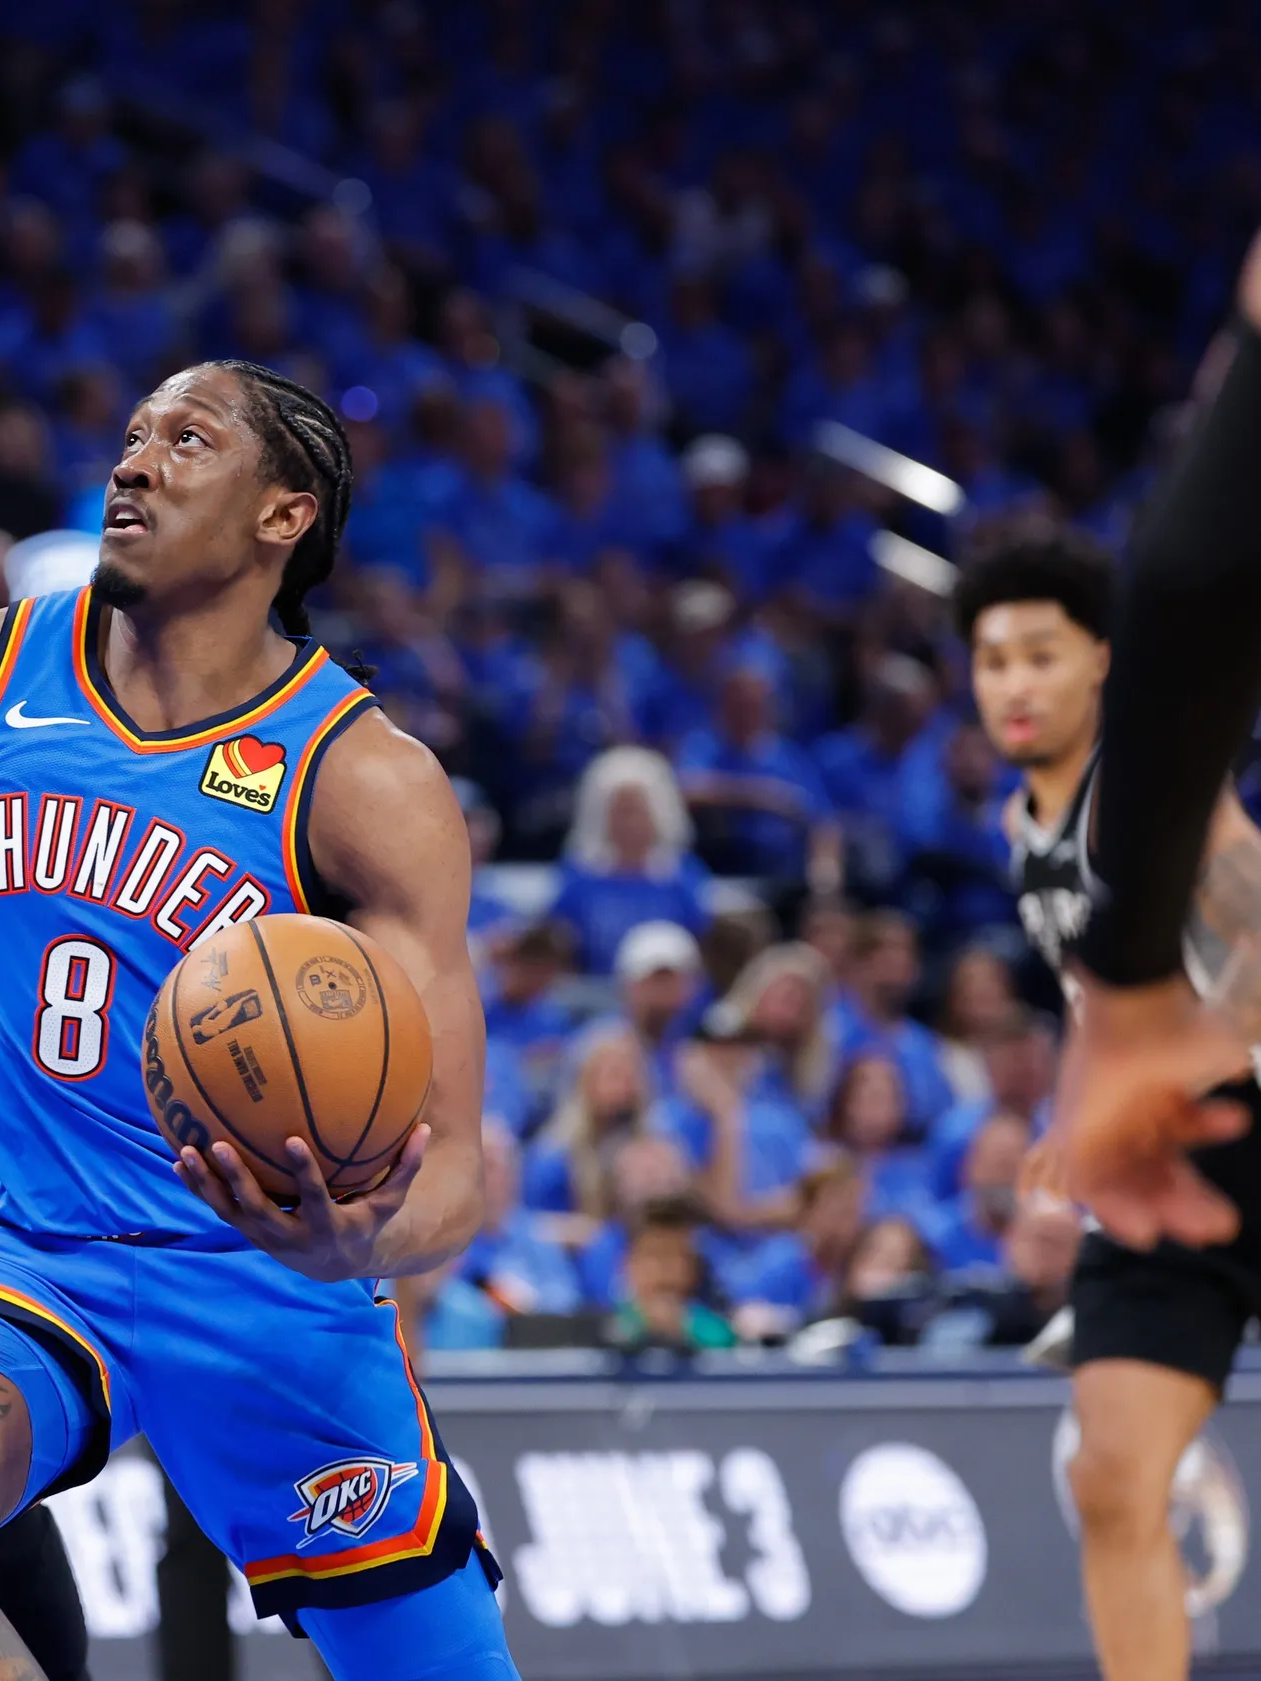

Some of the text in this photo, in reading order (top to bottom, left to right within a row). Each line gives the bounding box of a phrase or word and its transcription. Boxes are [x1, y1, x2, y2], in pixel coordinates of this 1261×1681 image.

[32, 933, 116, 1081] 8
[310, 1470, 371, 1530] OKC
[722, 1447, 811, 1620] 3
